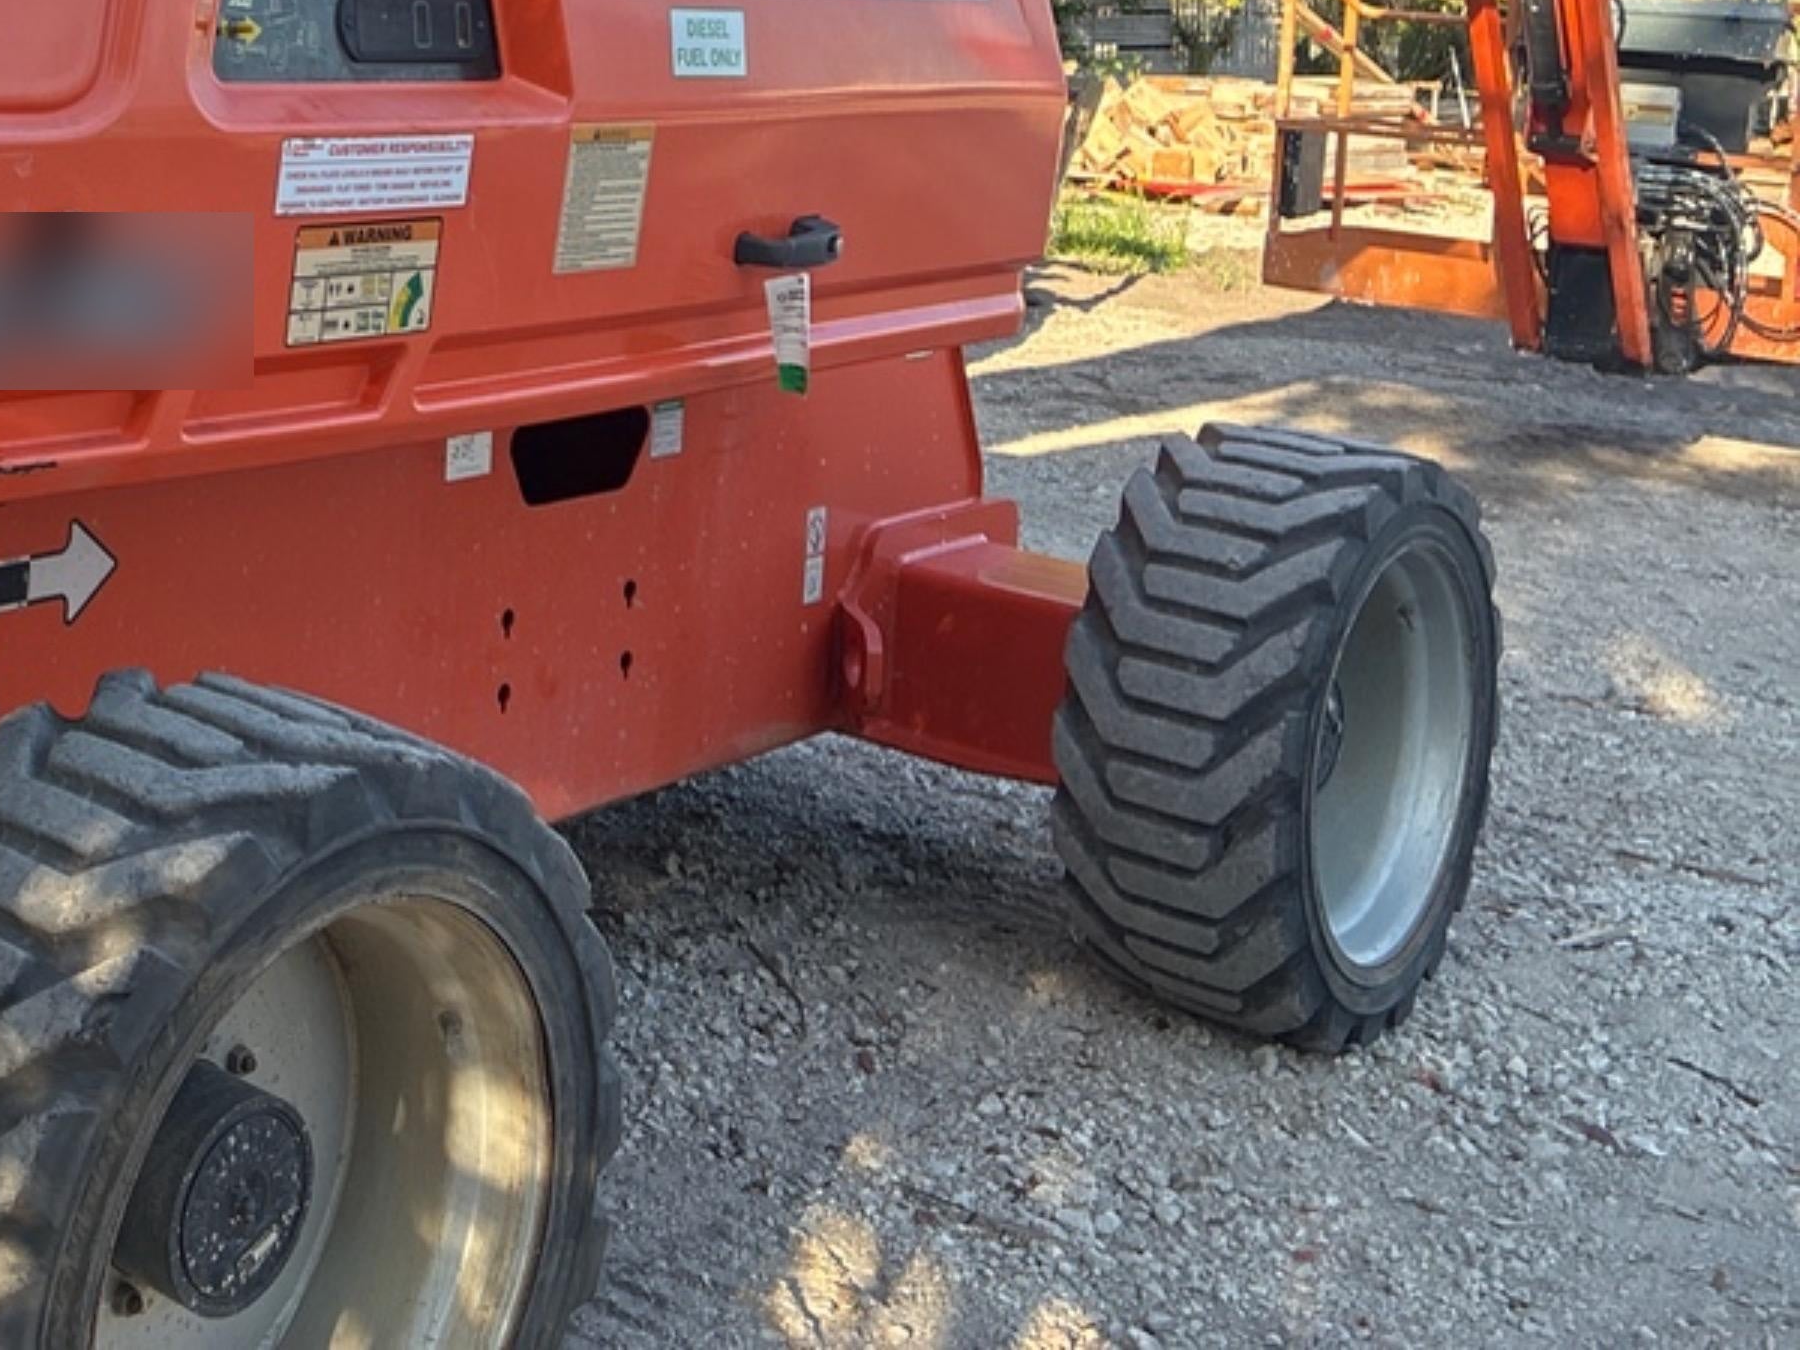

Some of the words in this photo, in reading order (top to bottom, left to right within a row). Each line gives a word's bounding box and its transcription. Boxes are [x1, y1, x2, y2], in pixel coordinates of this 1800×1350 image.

[686, 18, 729, 38] DIESEL
[677, 48, 708, 66] FUEL
[711, 48, 741, 67] ONLY
[328, 143, 385, 157] CUSTOMER
[343, 225, 413, 245] WARNING
